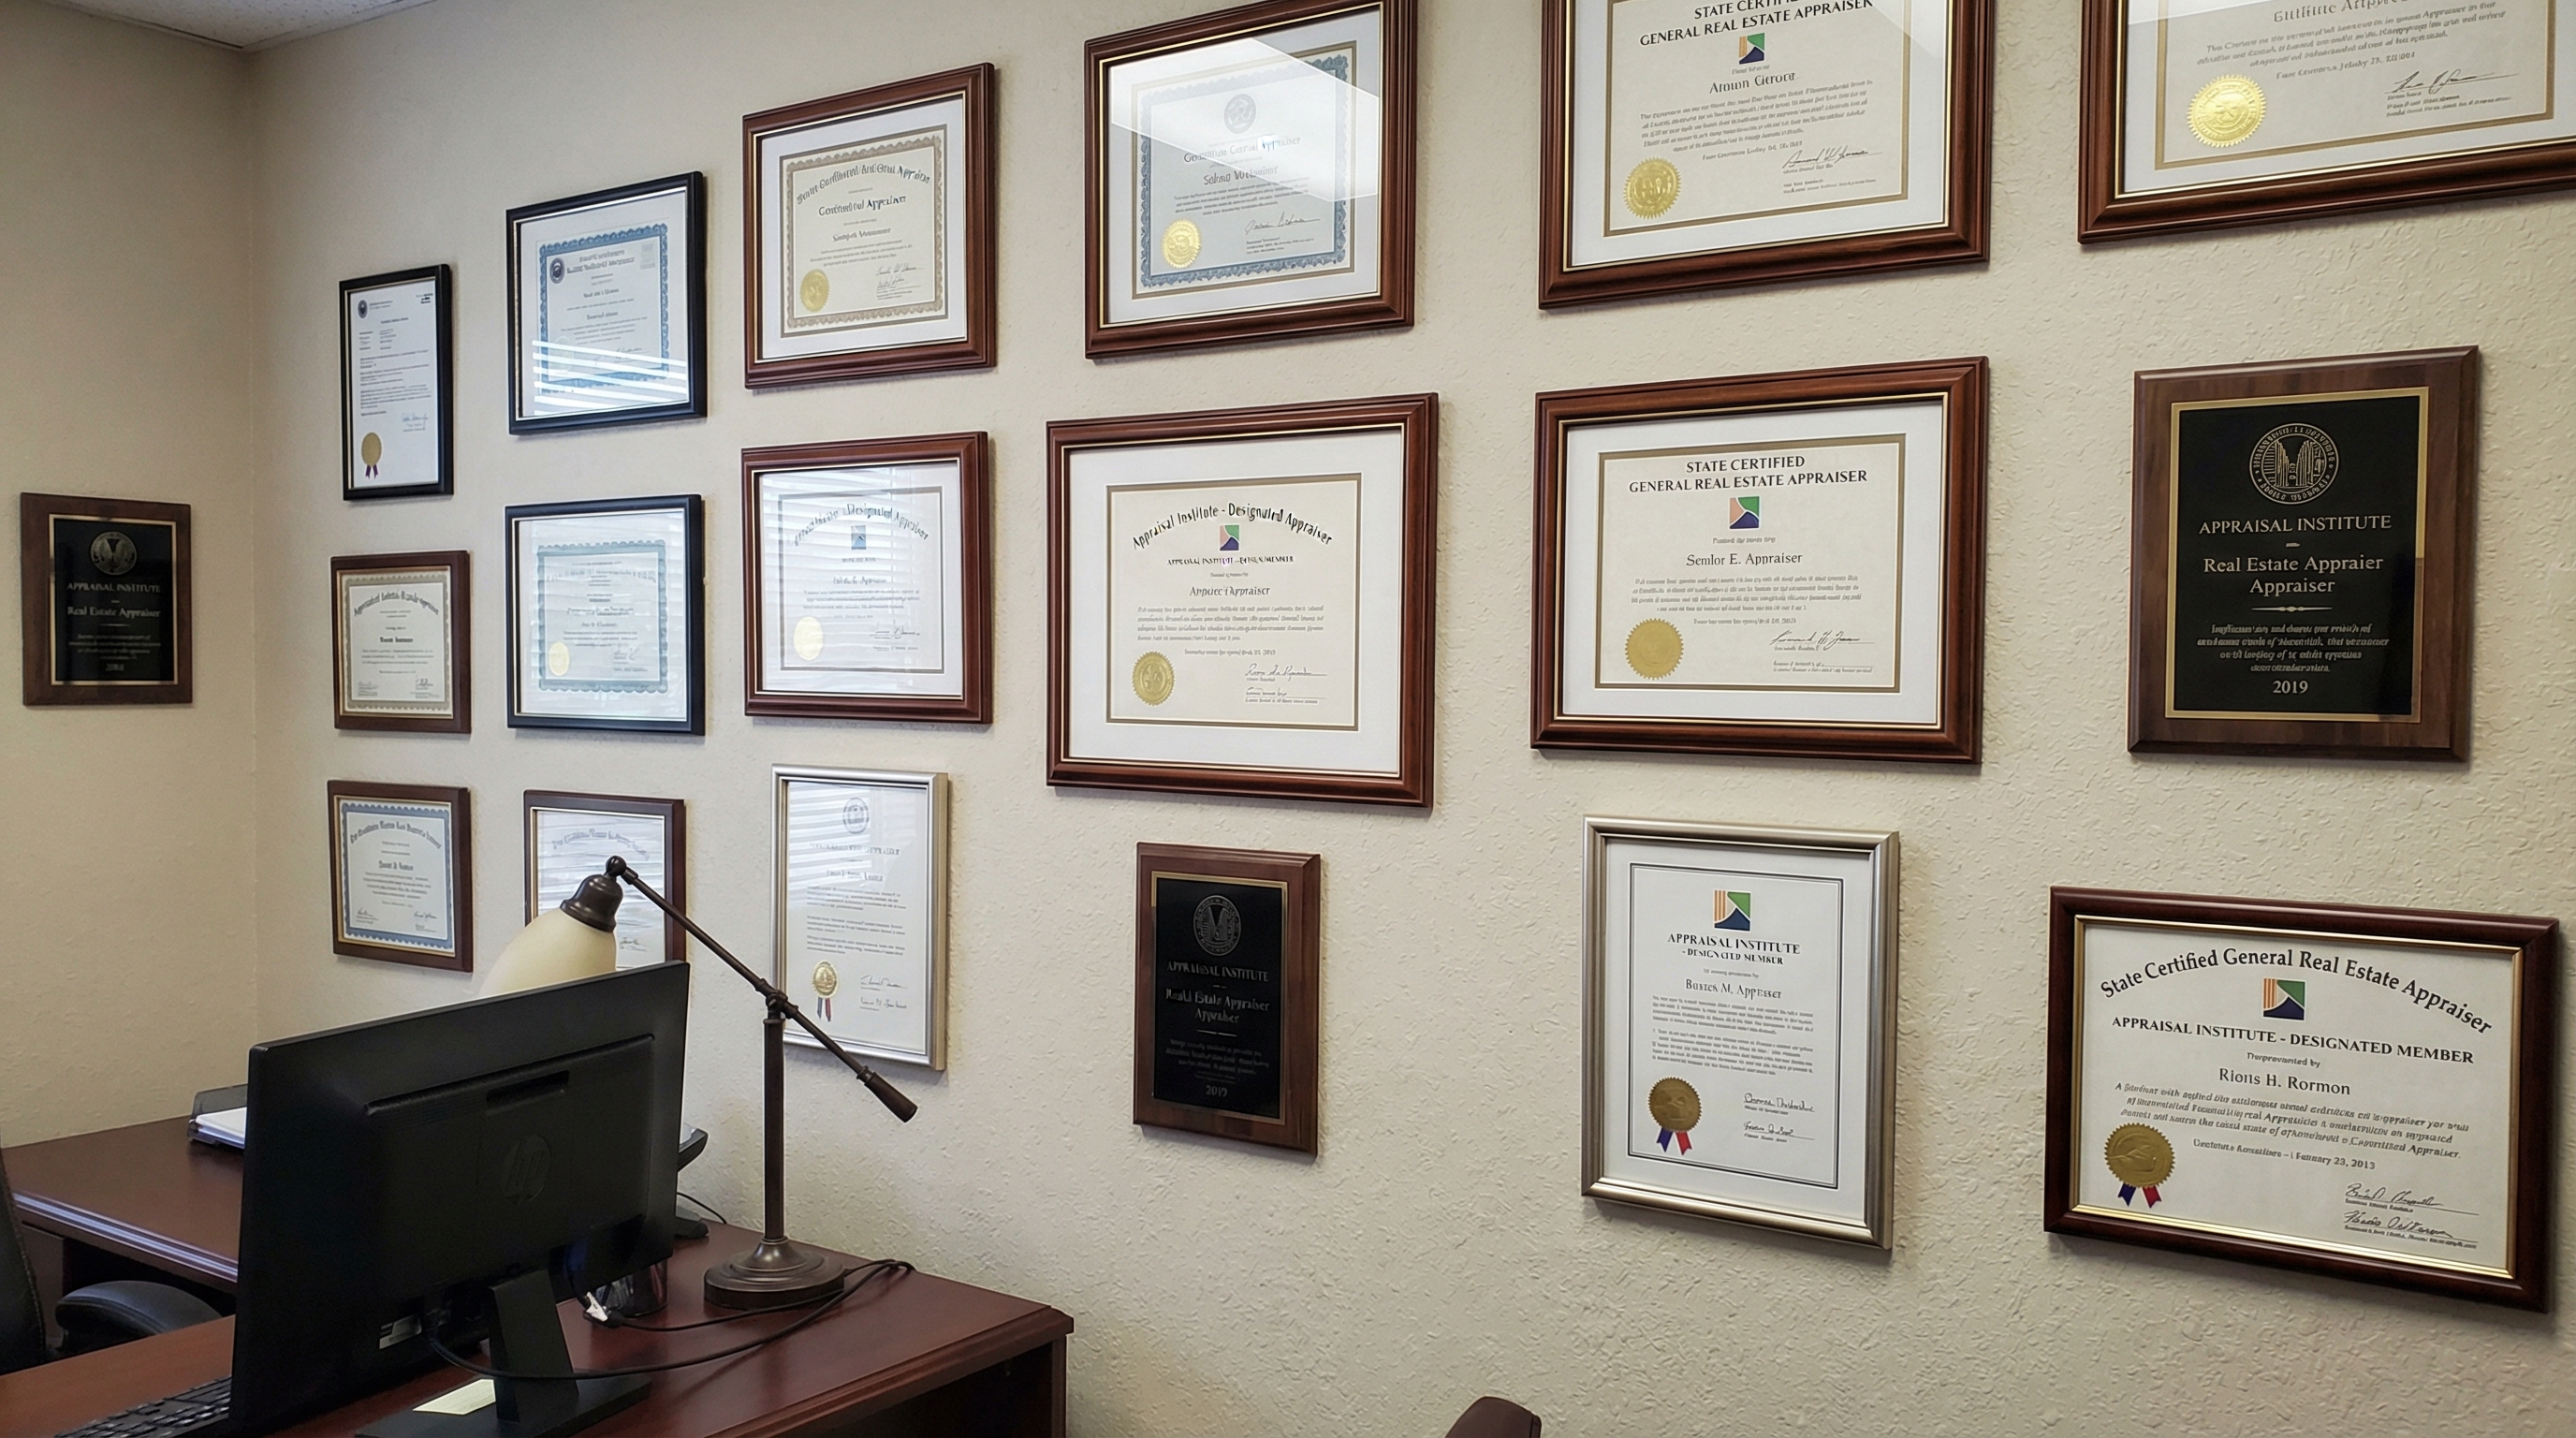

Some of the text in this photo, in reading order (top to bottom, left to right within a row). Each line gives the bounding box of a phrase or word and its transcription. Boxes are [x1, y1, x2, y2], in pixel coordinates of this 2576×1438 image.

[1694, 0, 1734, 20] STATE
[1640, 0, 1873, 46] GENERAL REAL ESTATE APPRAISER
[1686, 455, 1806, 473] STATE CERTIFIED
[1629, 470, 1867, 493] GENERAL REAL ESTATE APPRAISER
[2199, 515, 2392, 534] APPRAISAL INSTITUTE
[2203, 554, 2384, 574] Real Estate Appraier
[2249, 578, 2335, 596] Appraiser
[2273, 680, 2309, 694] 2019
[1735, 939, 1800, 954] INSTITUTE
[2100, 947, 2493, 1035] State Certified General Real Estate Appraiser
[2112, 1017, 2192, 1034] APPRAISAL
[2196, 1024, 2276, 1043] INSTITUTE
[2290, 1034, 2393, 1055] DESIGNATED
[2397, 1044, 2474, 1064] MEMBER
[2266, 1074, 2282, 1088] H.
[2288, 1076, 2350, 1095] Rormon
[2351, 1159, 2376, 1169] 2013
